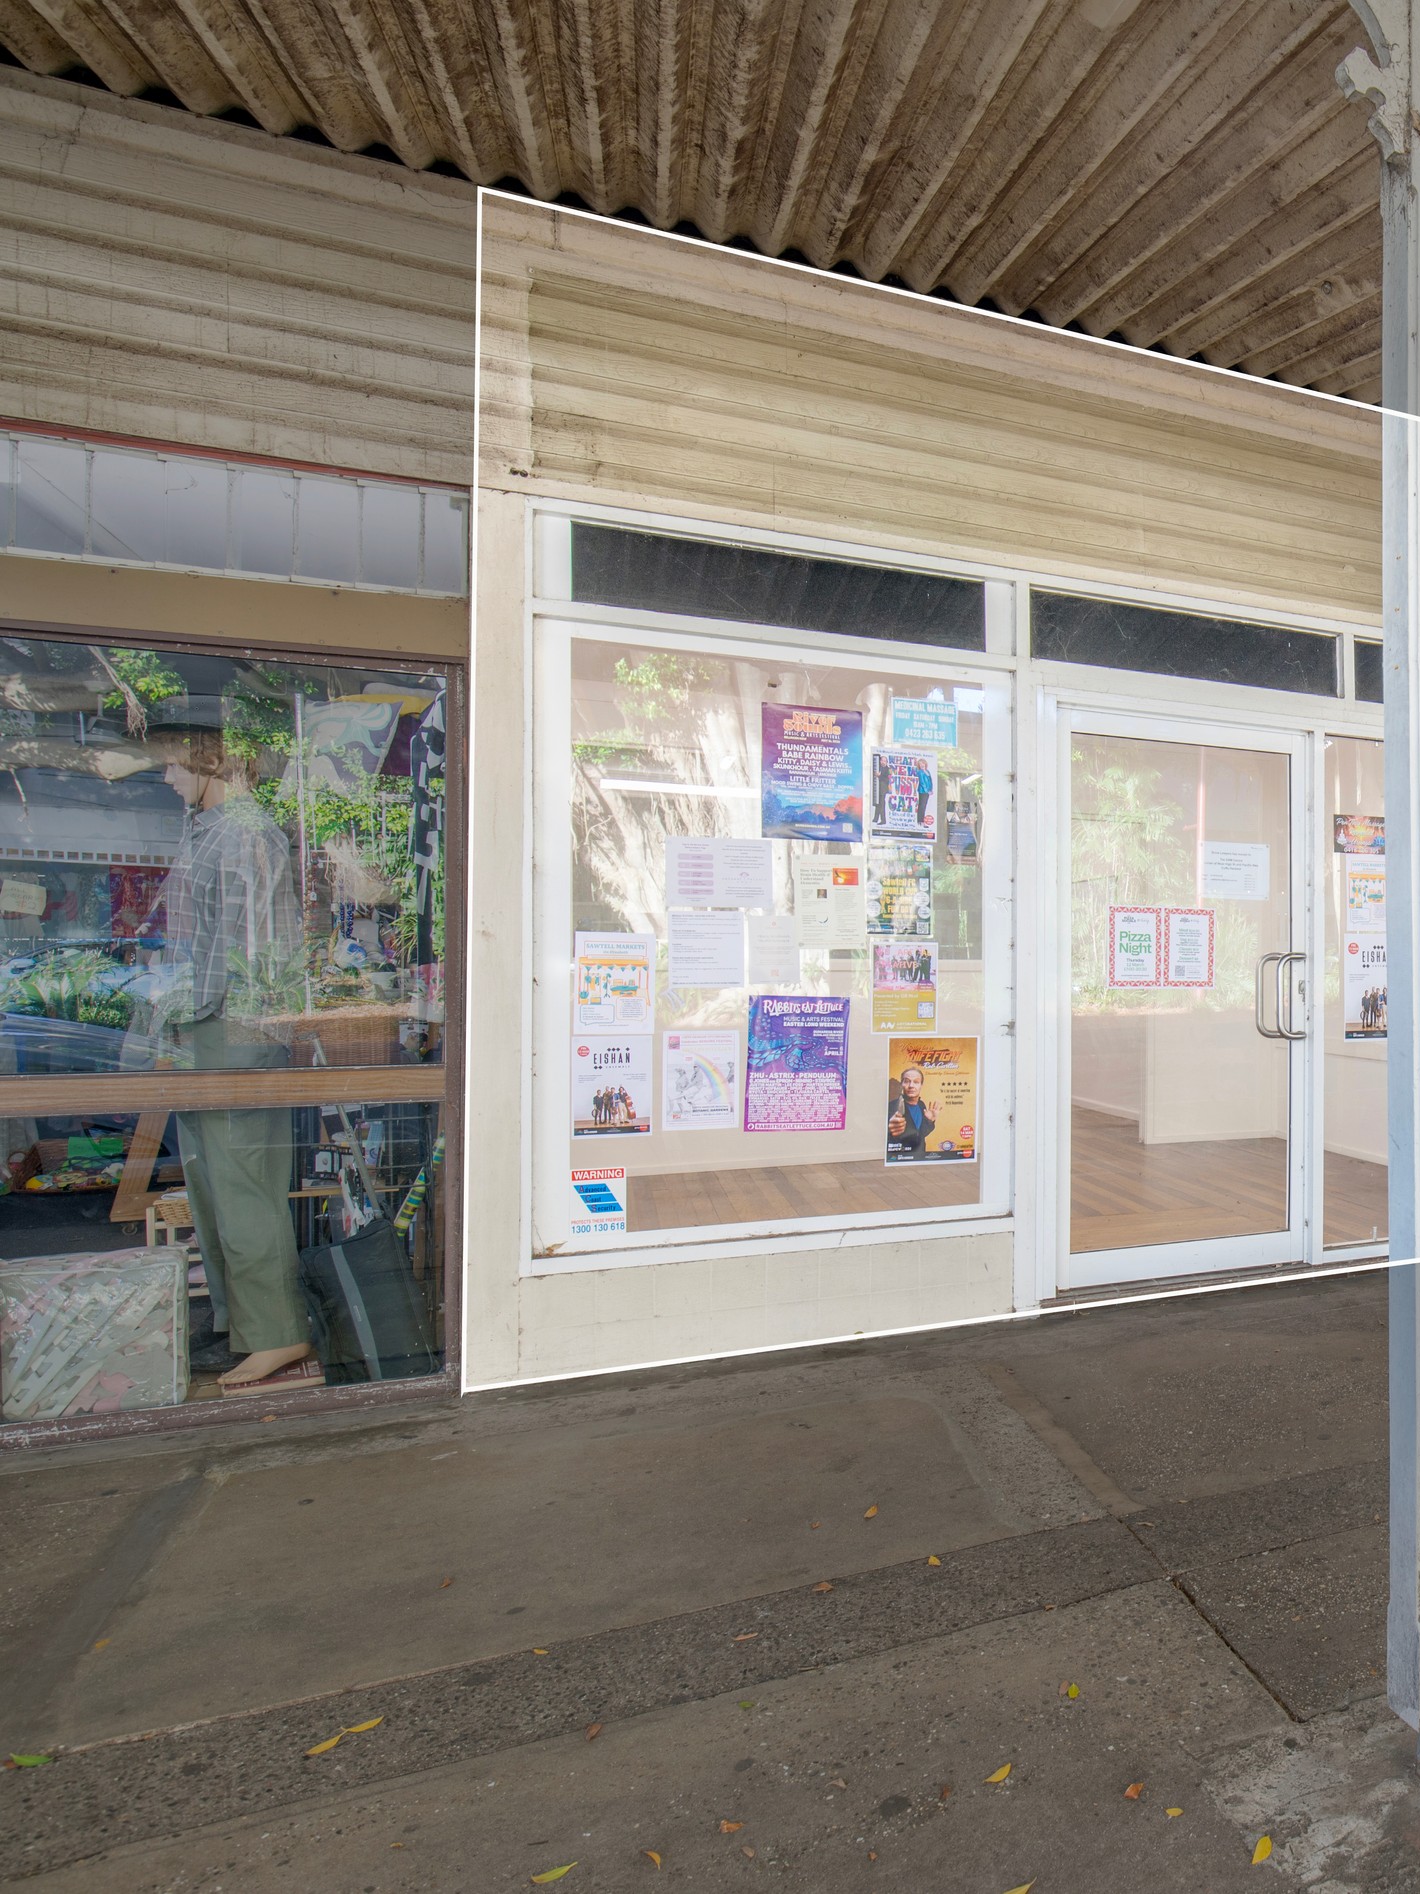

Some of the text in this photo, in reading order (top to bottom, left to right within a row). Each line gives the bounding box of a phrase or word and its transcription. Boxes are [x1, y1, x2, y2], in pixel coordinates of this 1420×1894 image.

[894, 700, 955, 714] MEDICINAL MASSAGE
[777, 743, 848, 755] THUNDAMENTALS
[805, 752, 843, 761] RAINBOW
[1119, 930, 1151, 942] Pizza
[1119, 942, 1152, 956] Night
[1362, 951, 1386, 963] EISHA
[593, 1052, 630, 1065] EISHAN
[573, 1169, 623, 1180] WARNING
[591, 1204, 616, 1213] Security
[571, 1221, 625, 1234] 1300 130 618
